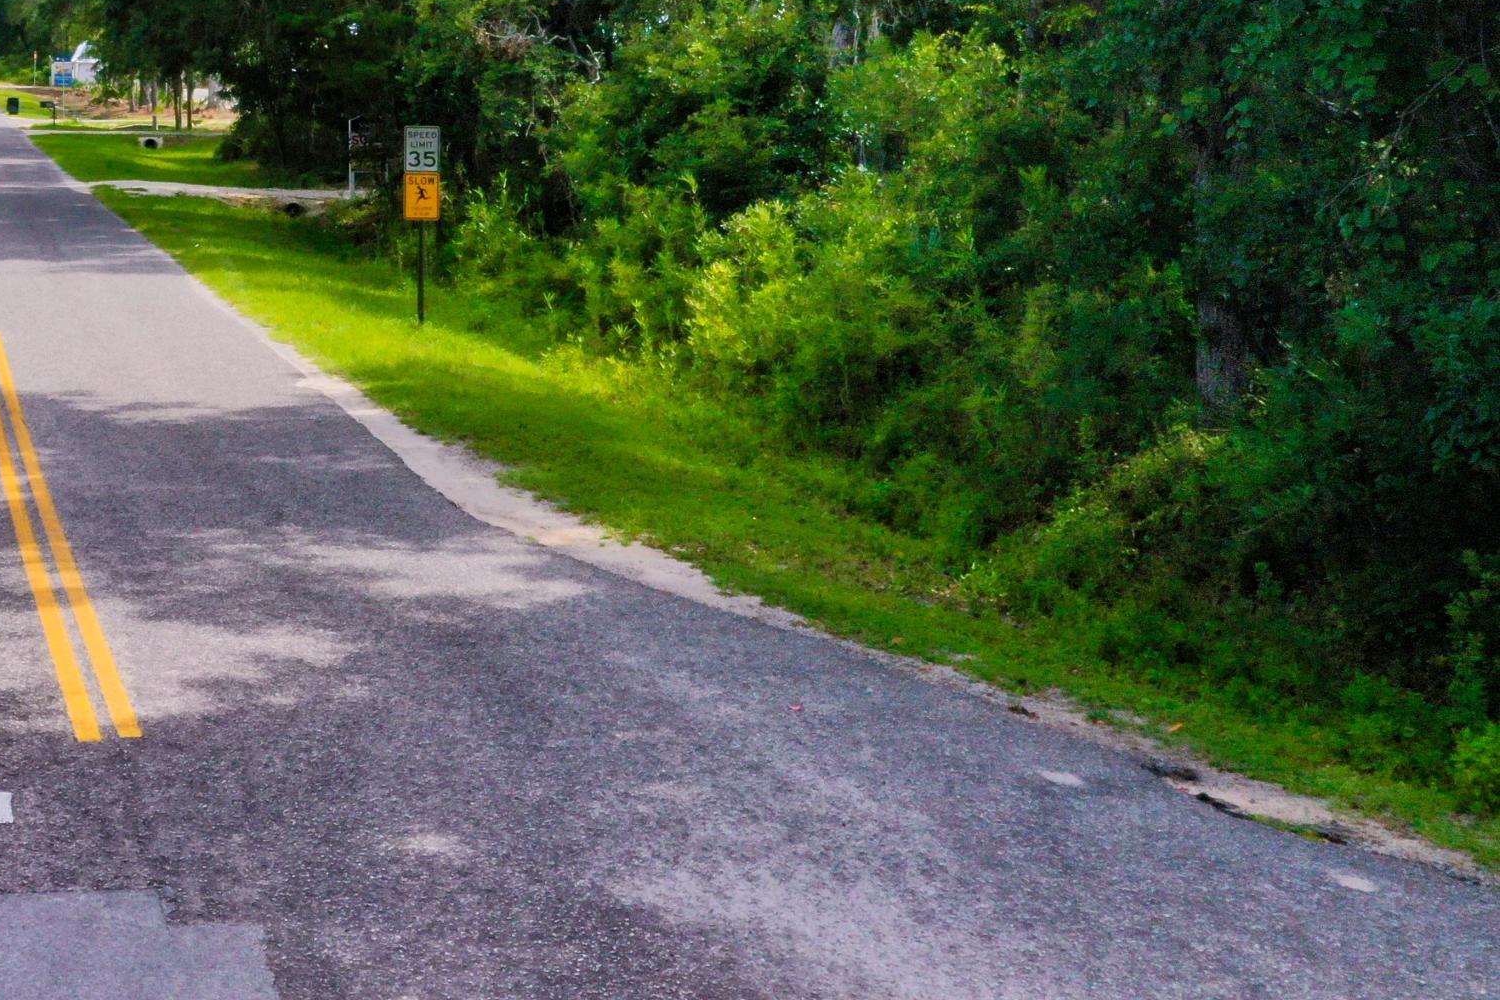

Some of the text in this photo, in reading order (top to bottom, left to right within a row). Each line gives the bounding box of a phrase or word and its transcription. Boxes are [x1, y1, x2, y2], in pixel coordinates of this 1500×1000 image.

[408, 131, 437, 139] SPEED
[408, 151, 436, 167] 35
[408, 176, 435, 185] SLOW
